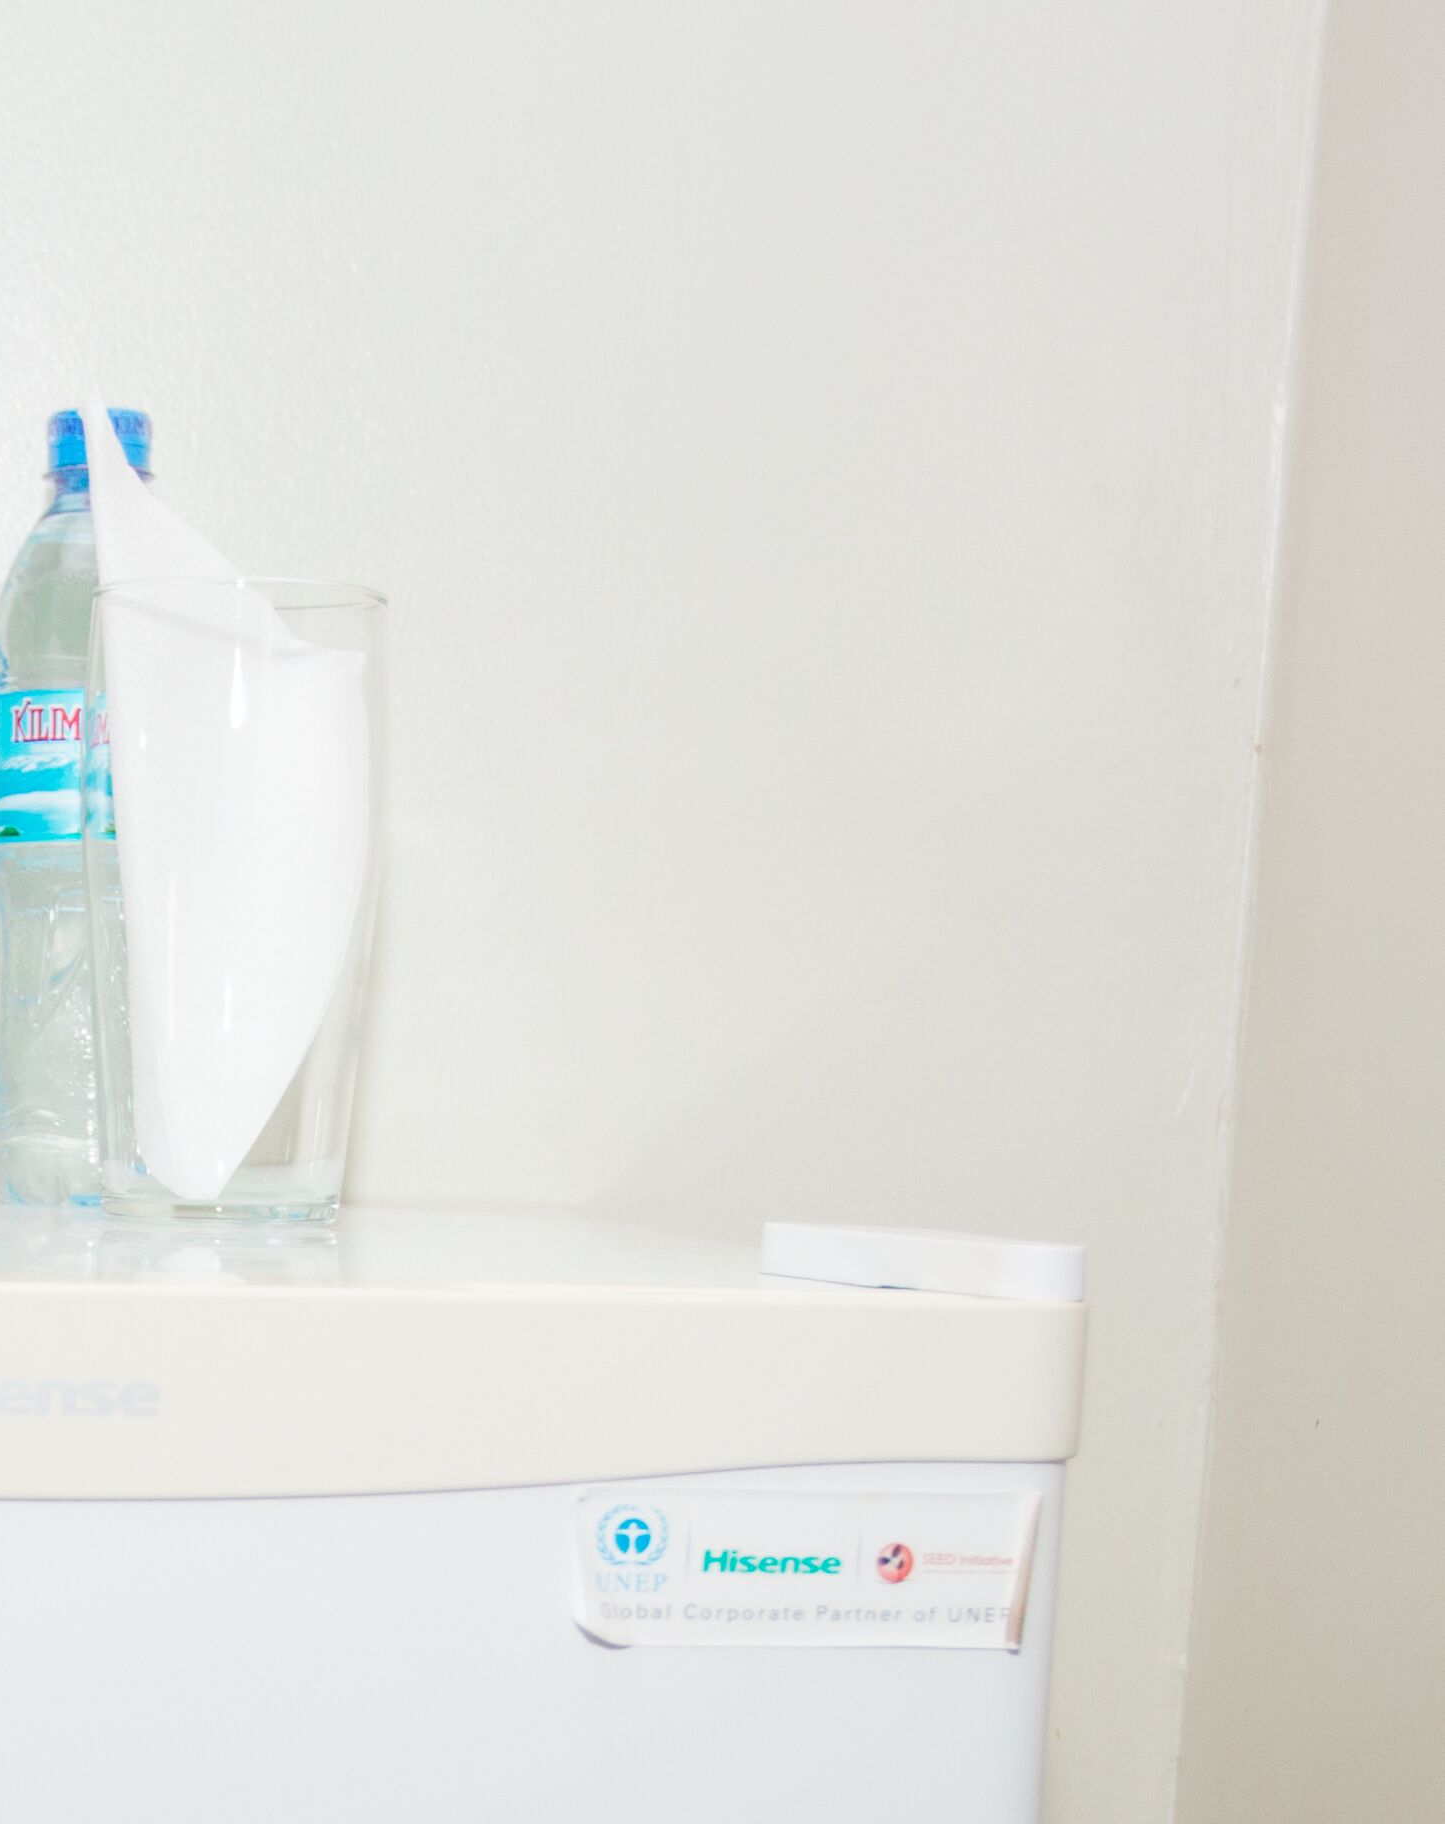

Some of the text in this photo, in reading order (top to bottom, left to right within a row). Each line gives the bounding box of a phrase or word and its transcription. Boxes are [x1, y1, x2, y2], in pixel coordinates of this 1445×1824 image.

[702, 1549, 842, 1574] Hisense
[596, 1573, 667, 1592] UNEP
[601, 1602, 671, 1620] Global
[683, 1603, 803, 1623] Corporate
[816, 1605, 901, 1622] Partner
[913, 1606, 937, 1623] of
